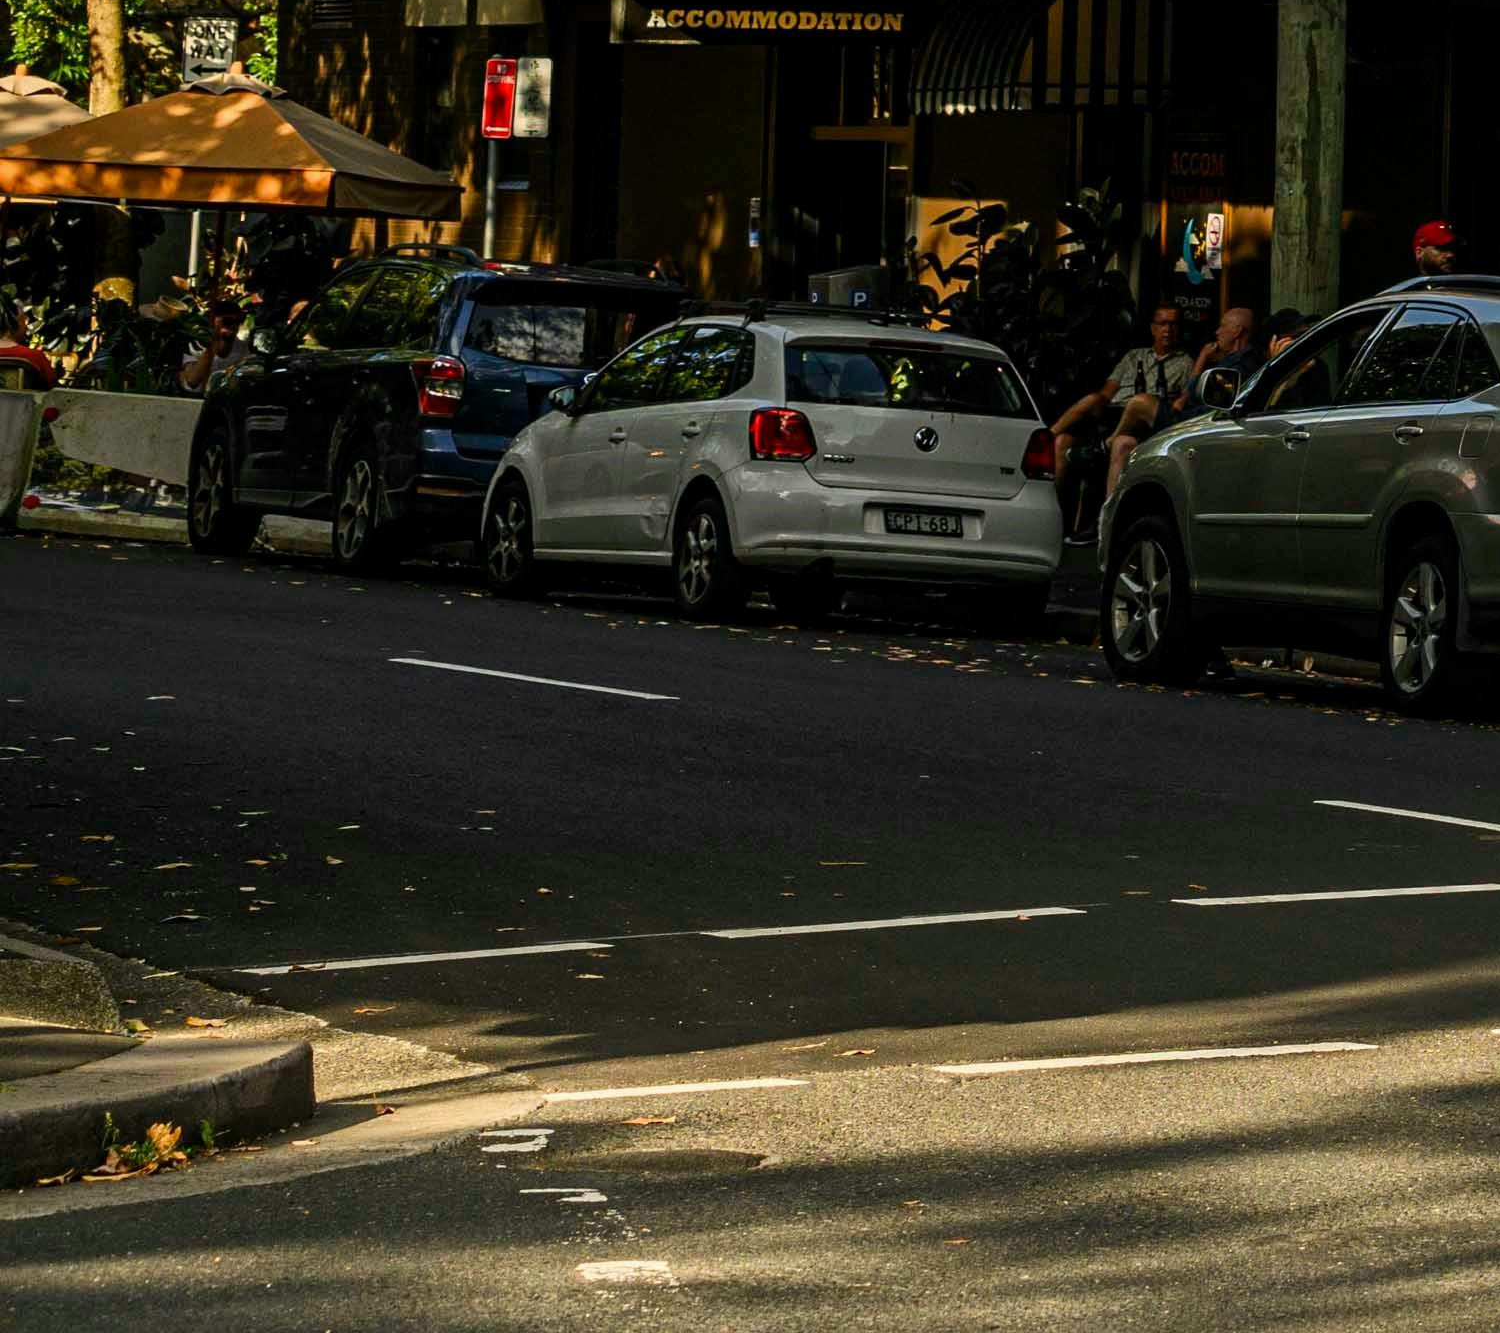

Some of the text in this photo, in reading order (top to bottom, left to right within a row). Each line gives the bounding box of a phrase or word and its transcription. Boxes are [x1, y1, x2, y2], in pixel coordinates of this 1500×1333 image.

[646, 9, 904, 31] ACCOMMODATION
[194, 24, 229, 39] ONE
[191, 44, 228, 59] WAY
[854, 292, 867, 307] P
